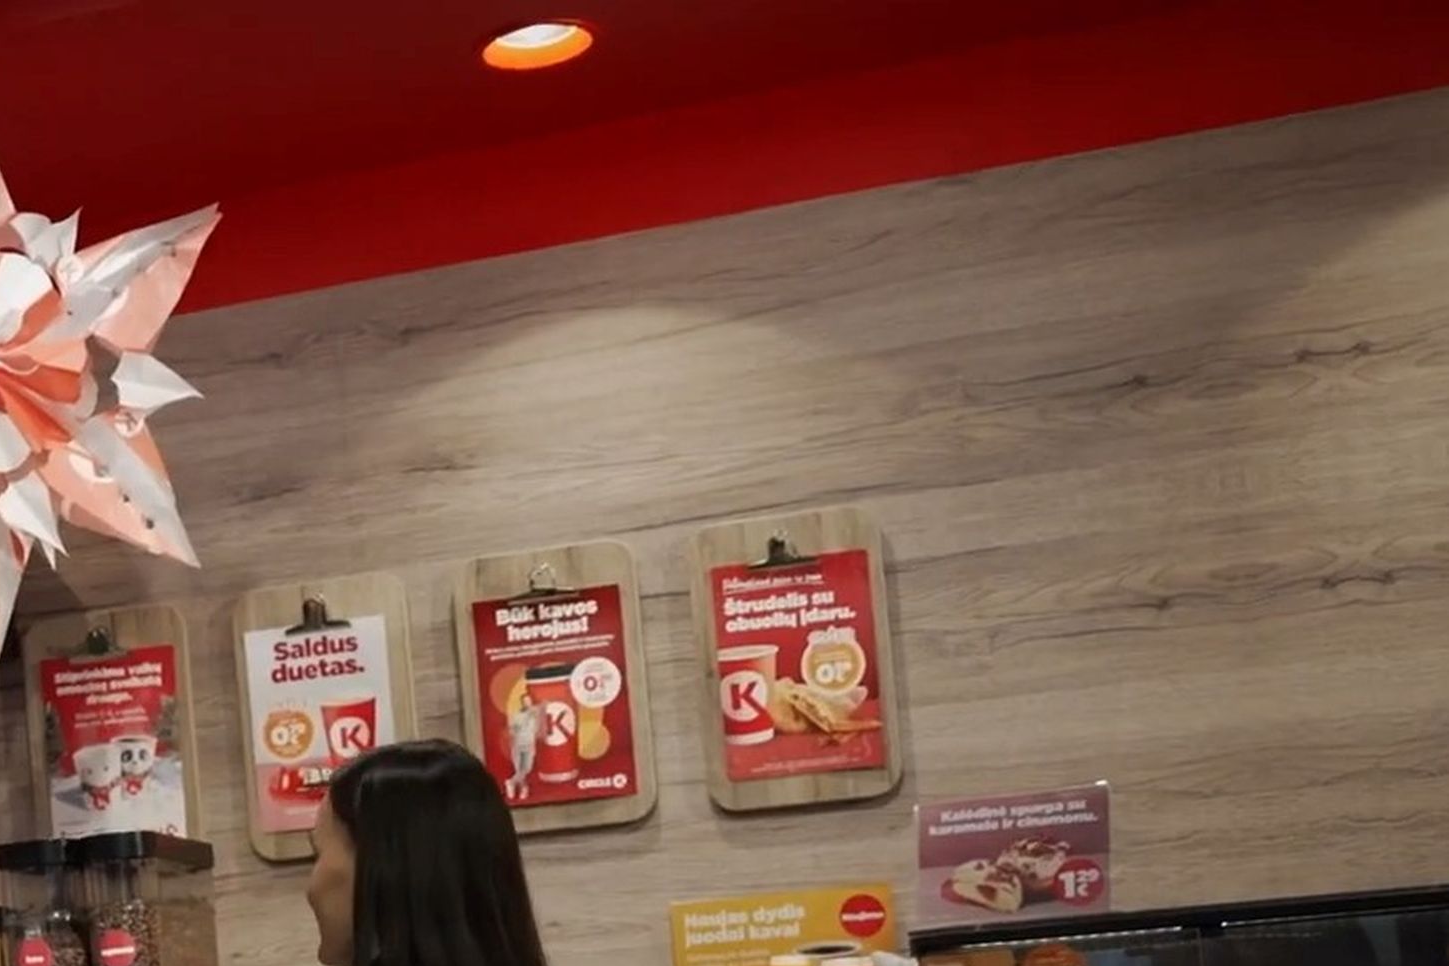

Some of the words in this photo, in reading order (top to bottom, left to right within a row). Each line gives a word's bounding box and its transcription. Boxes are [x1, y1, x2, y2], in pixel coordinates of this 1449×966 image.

[494, 605, 537, 627] Būk
[538, 599, 599, 620] kavos
[723, 592, 809, 617] Štrudelis
[811, 590, 835, 606] su
[506, 616, 590, 643] herojus!
[272, 633, 359, 663] Saldus
[270, 655, 366, 684] duetas.
[730, 680, 765, 713] K
[340, 724, 370, 750] K
[546, 710, 572, 739] K
[1066, 798, 1088, 812] su
[1002, 818, 1015, 831] ir
[751, 902, 807, 925] dydis
